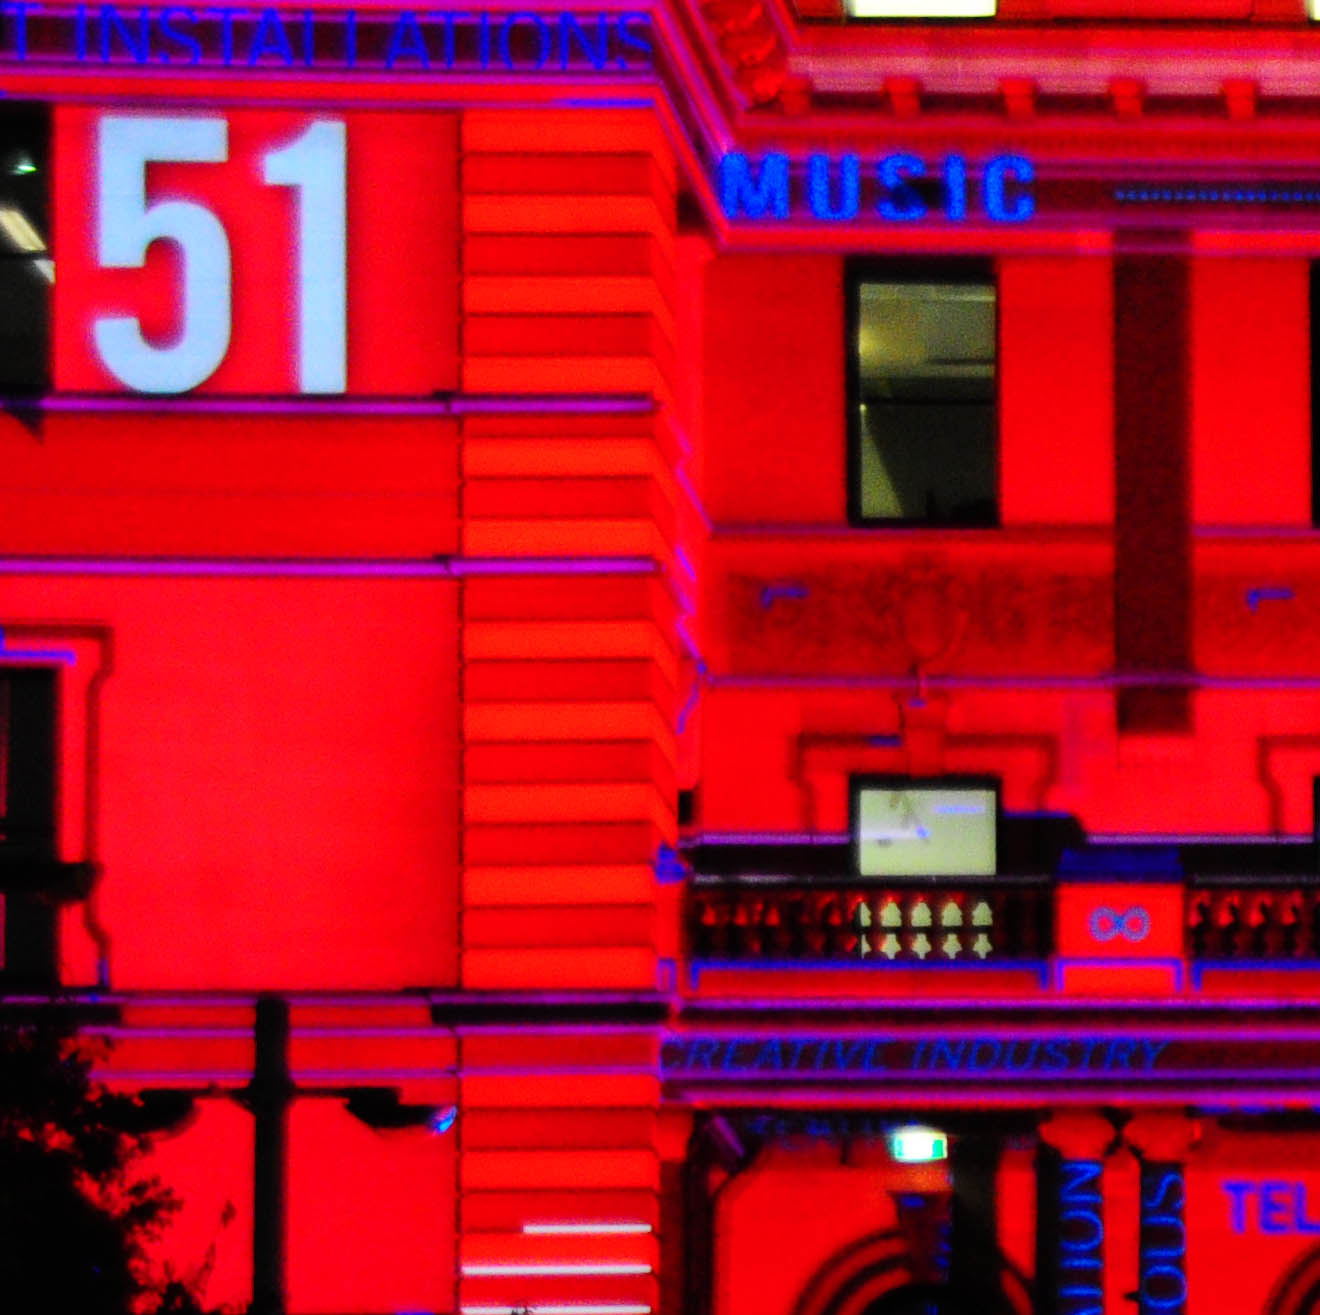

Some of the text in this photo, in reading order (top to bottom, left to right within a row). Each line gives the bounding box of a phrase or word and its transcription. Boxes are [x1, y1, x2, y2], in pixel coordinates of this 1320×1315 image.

[718, 152, 1036, 223] MUSIC
[94, 114, 347, 394] 51
[911, 1036, 1170, 1076] INDUSTRY
